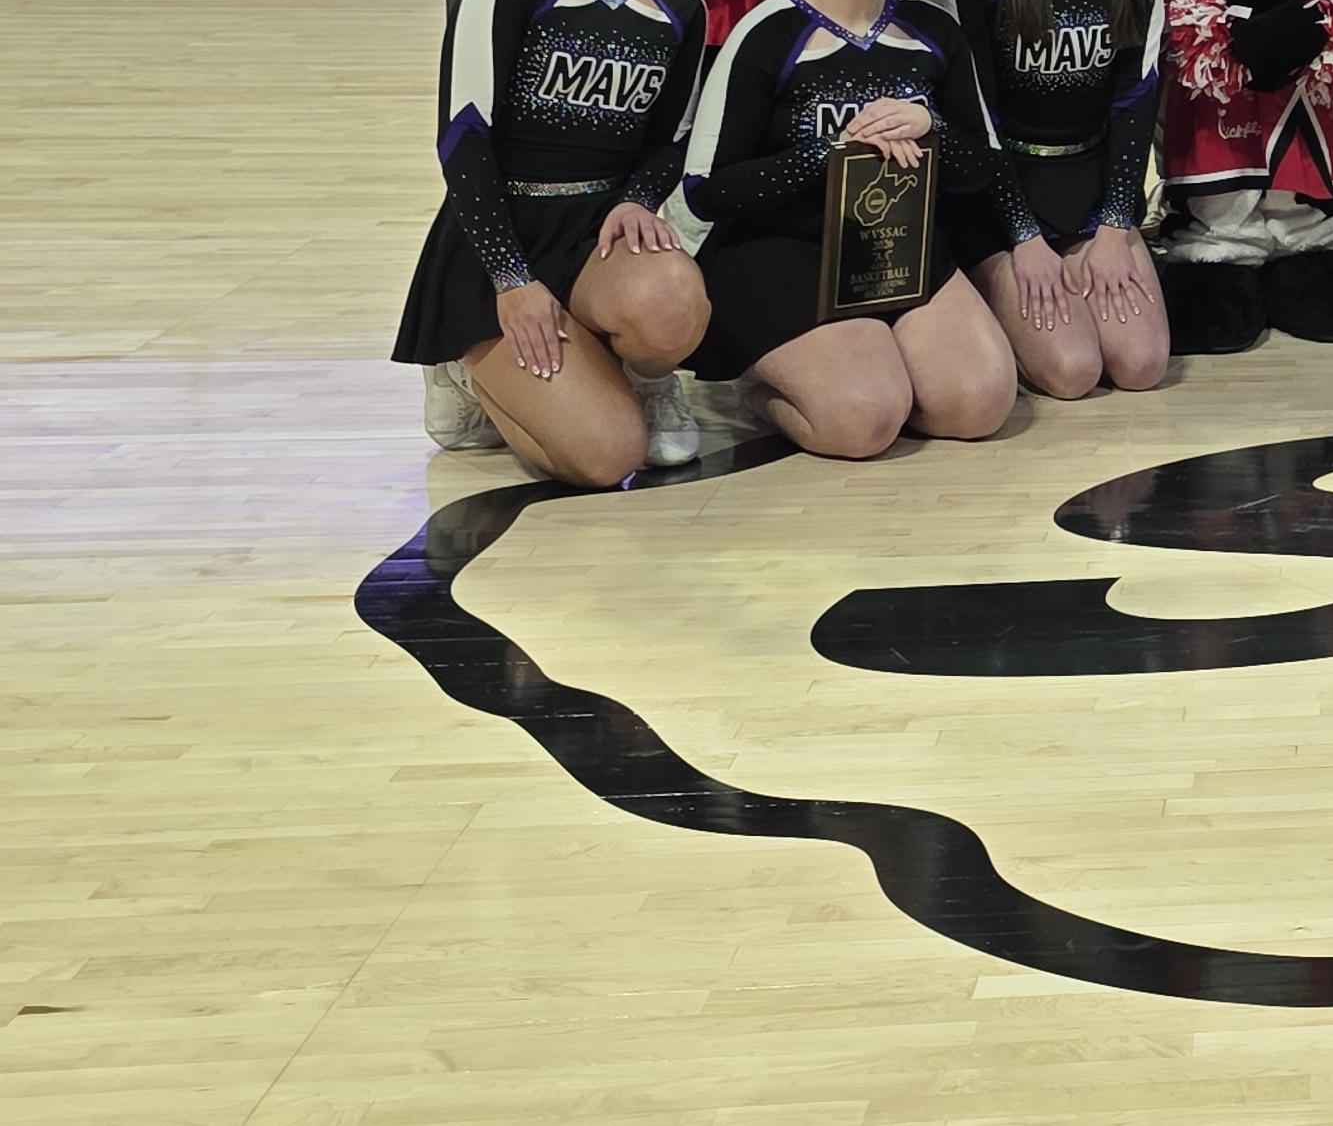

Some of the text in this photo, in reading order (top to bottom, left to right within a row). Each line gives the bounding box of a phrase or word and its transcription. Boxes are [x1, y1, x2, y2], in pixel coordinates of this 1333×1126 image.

[1015, 24, 1118, 74] MAVS
[538, 51, 667, 114] MAVS
[860, 226, 908, 241] WVSSAC
